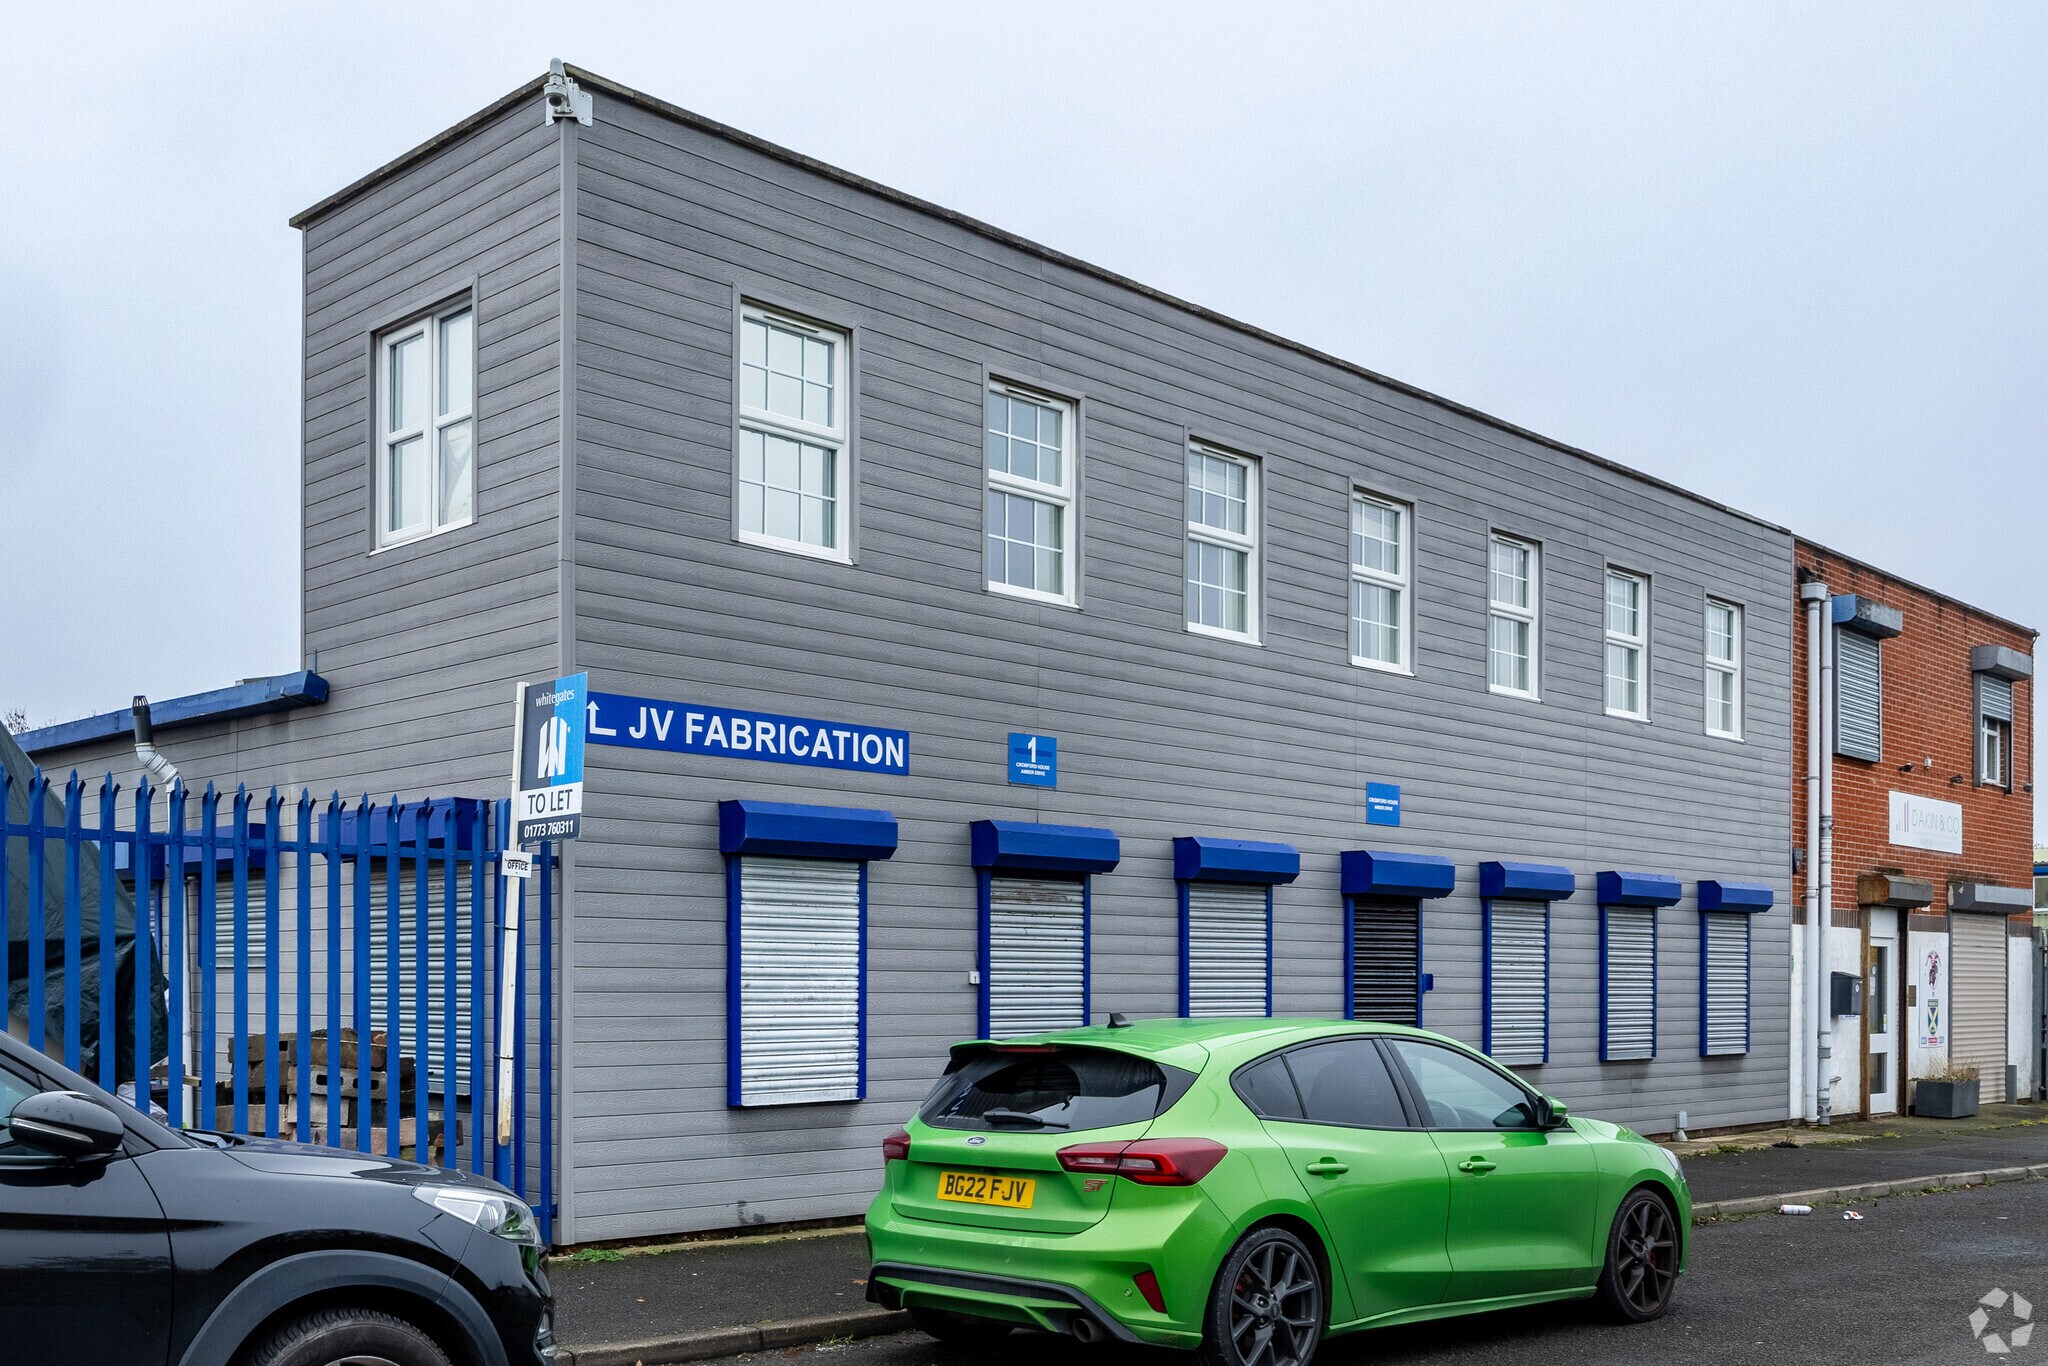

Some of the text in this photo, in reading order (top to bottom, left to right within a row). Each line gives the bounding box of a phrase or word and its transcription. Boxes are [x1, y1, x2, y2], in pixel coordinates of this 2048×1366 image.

[536, 689, 575, 707] whitegates
[628, 706, 905, 768] JV FABRICATION
[1027, 736, 1037, 764] 1
[528, 788, 573, 814] TO LET
[524, 820, 574, 838] 01773 760311
[1912, 809, 1960, 834] DAKIN & CO
[507, 861, 528, 871] OFFICE
[944, 1174, 1027, 1203] BG22 FJV
[1083, 1179, 1109, 1192] ST
